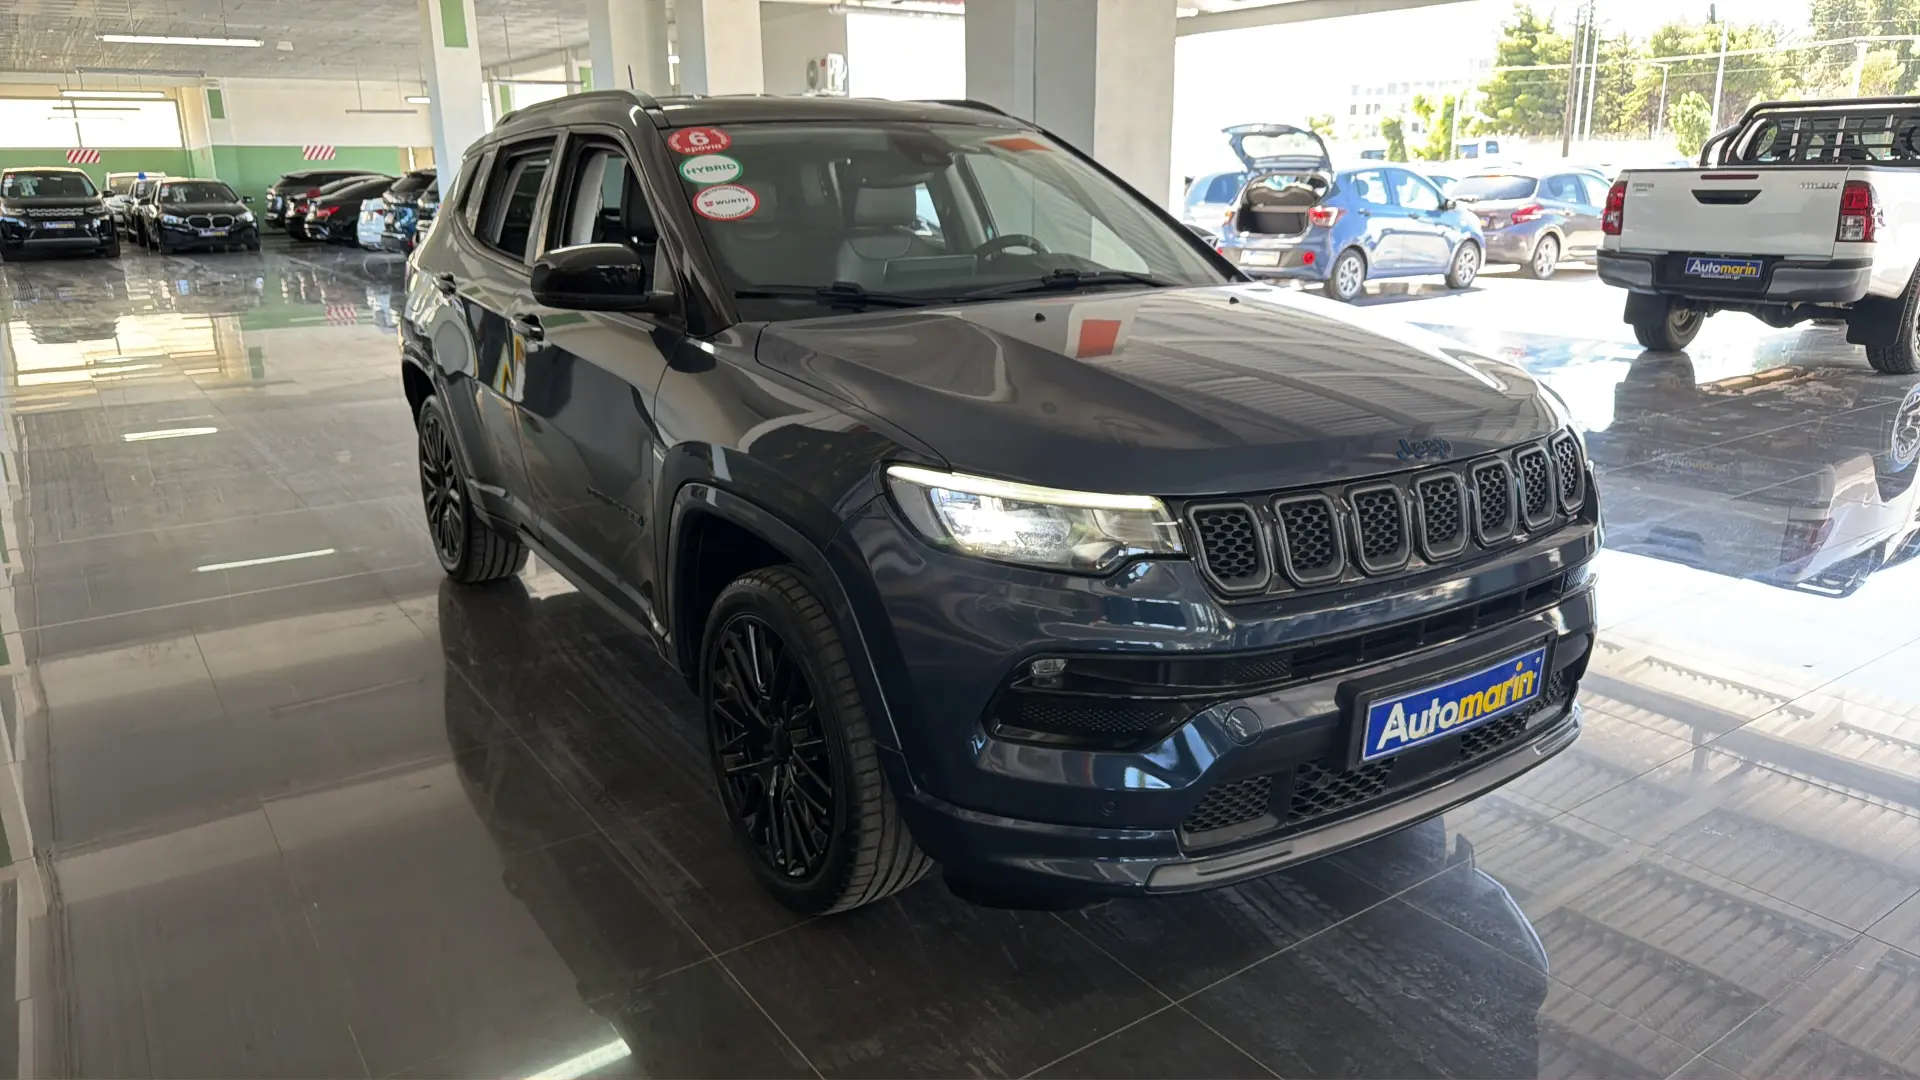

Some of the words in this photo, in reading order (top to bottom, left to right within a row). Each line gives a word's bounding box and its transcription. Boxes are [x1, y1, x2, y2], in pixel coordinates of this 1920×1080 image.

[688, 131, 710, 146] 6
[685, 163, 737, 175] HYBRID
[1689, 260, 1757, 275] Automarin
[1376, 660, 1535, 750] Automarin
